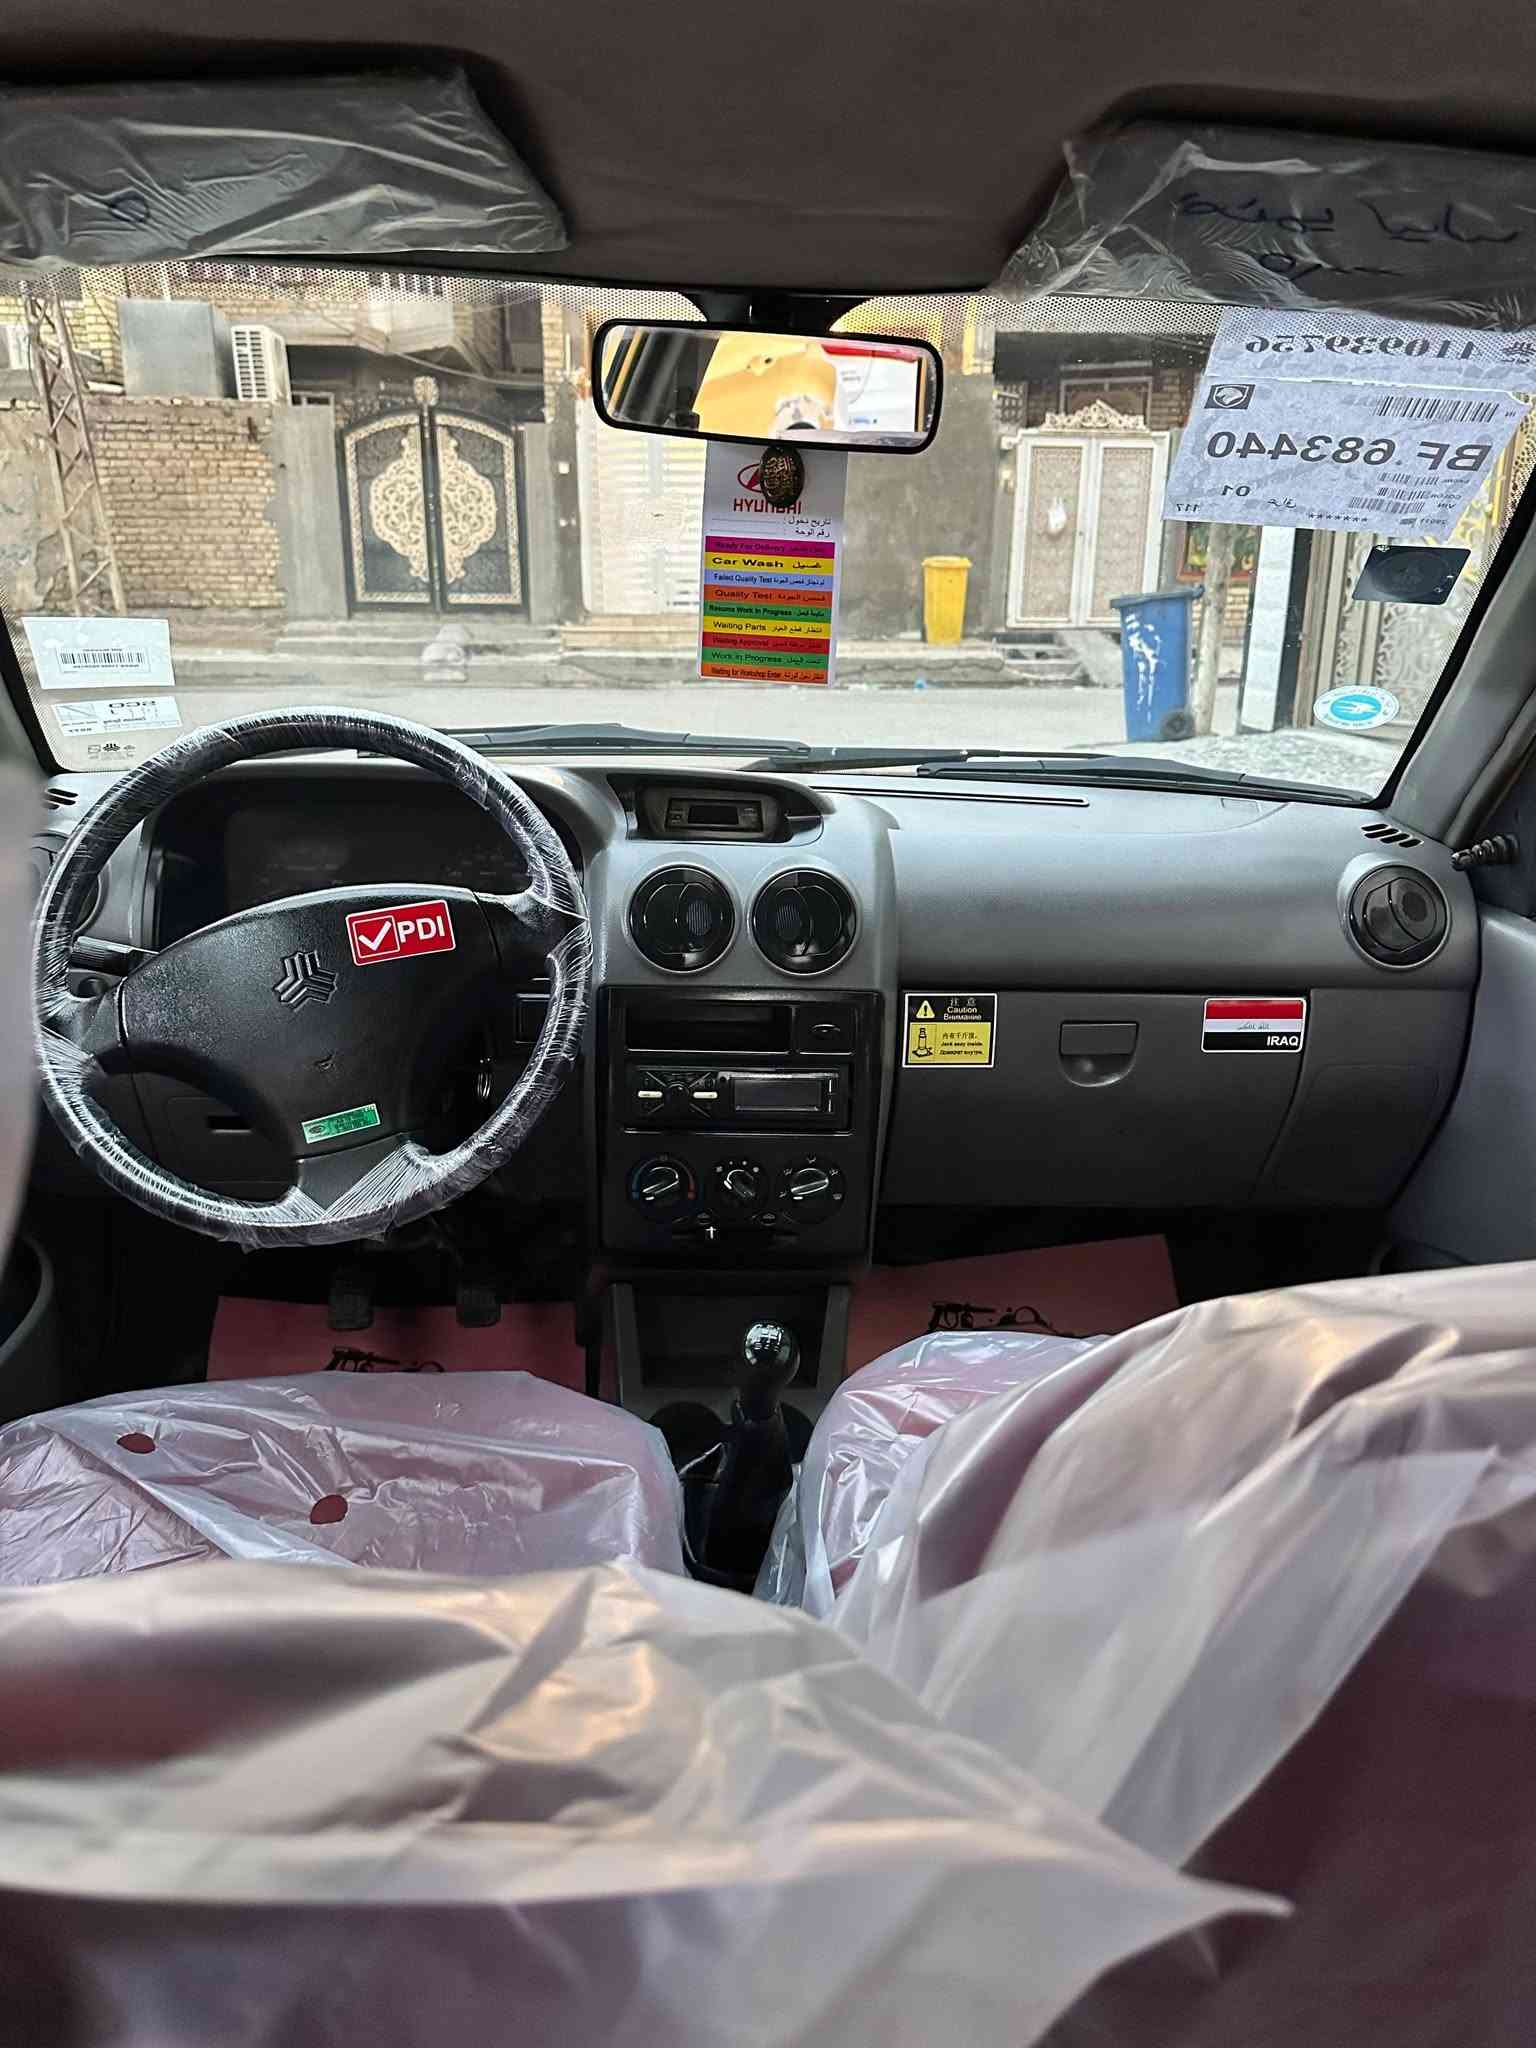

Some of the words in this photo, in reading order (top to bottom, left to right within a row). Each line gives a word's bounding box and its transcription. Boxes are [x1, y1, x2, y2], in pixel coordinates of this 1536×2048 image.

[712, 557, 738, 566] Car
[742, 559, 784, 568] Wash
[715, 589, 750, 599] Quality
[752, 591, 773, 599] Test
[713, 621, 743, 631] Waiting
[745, 623, 767, 631] Parts
[712, 652, 733, 660] Work
[745, 653, 783, 664] Progress
[397, 915, 446, 943] PDI
[946, 1006, 978, 1014] Caution
[1266, 1035, 1299, 1047] IRAQ
